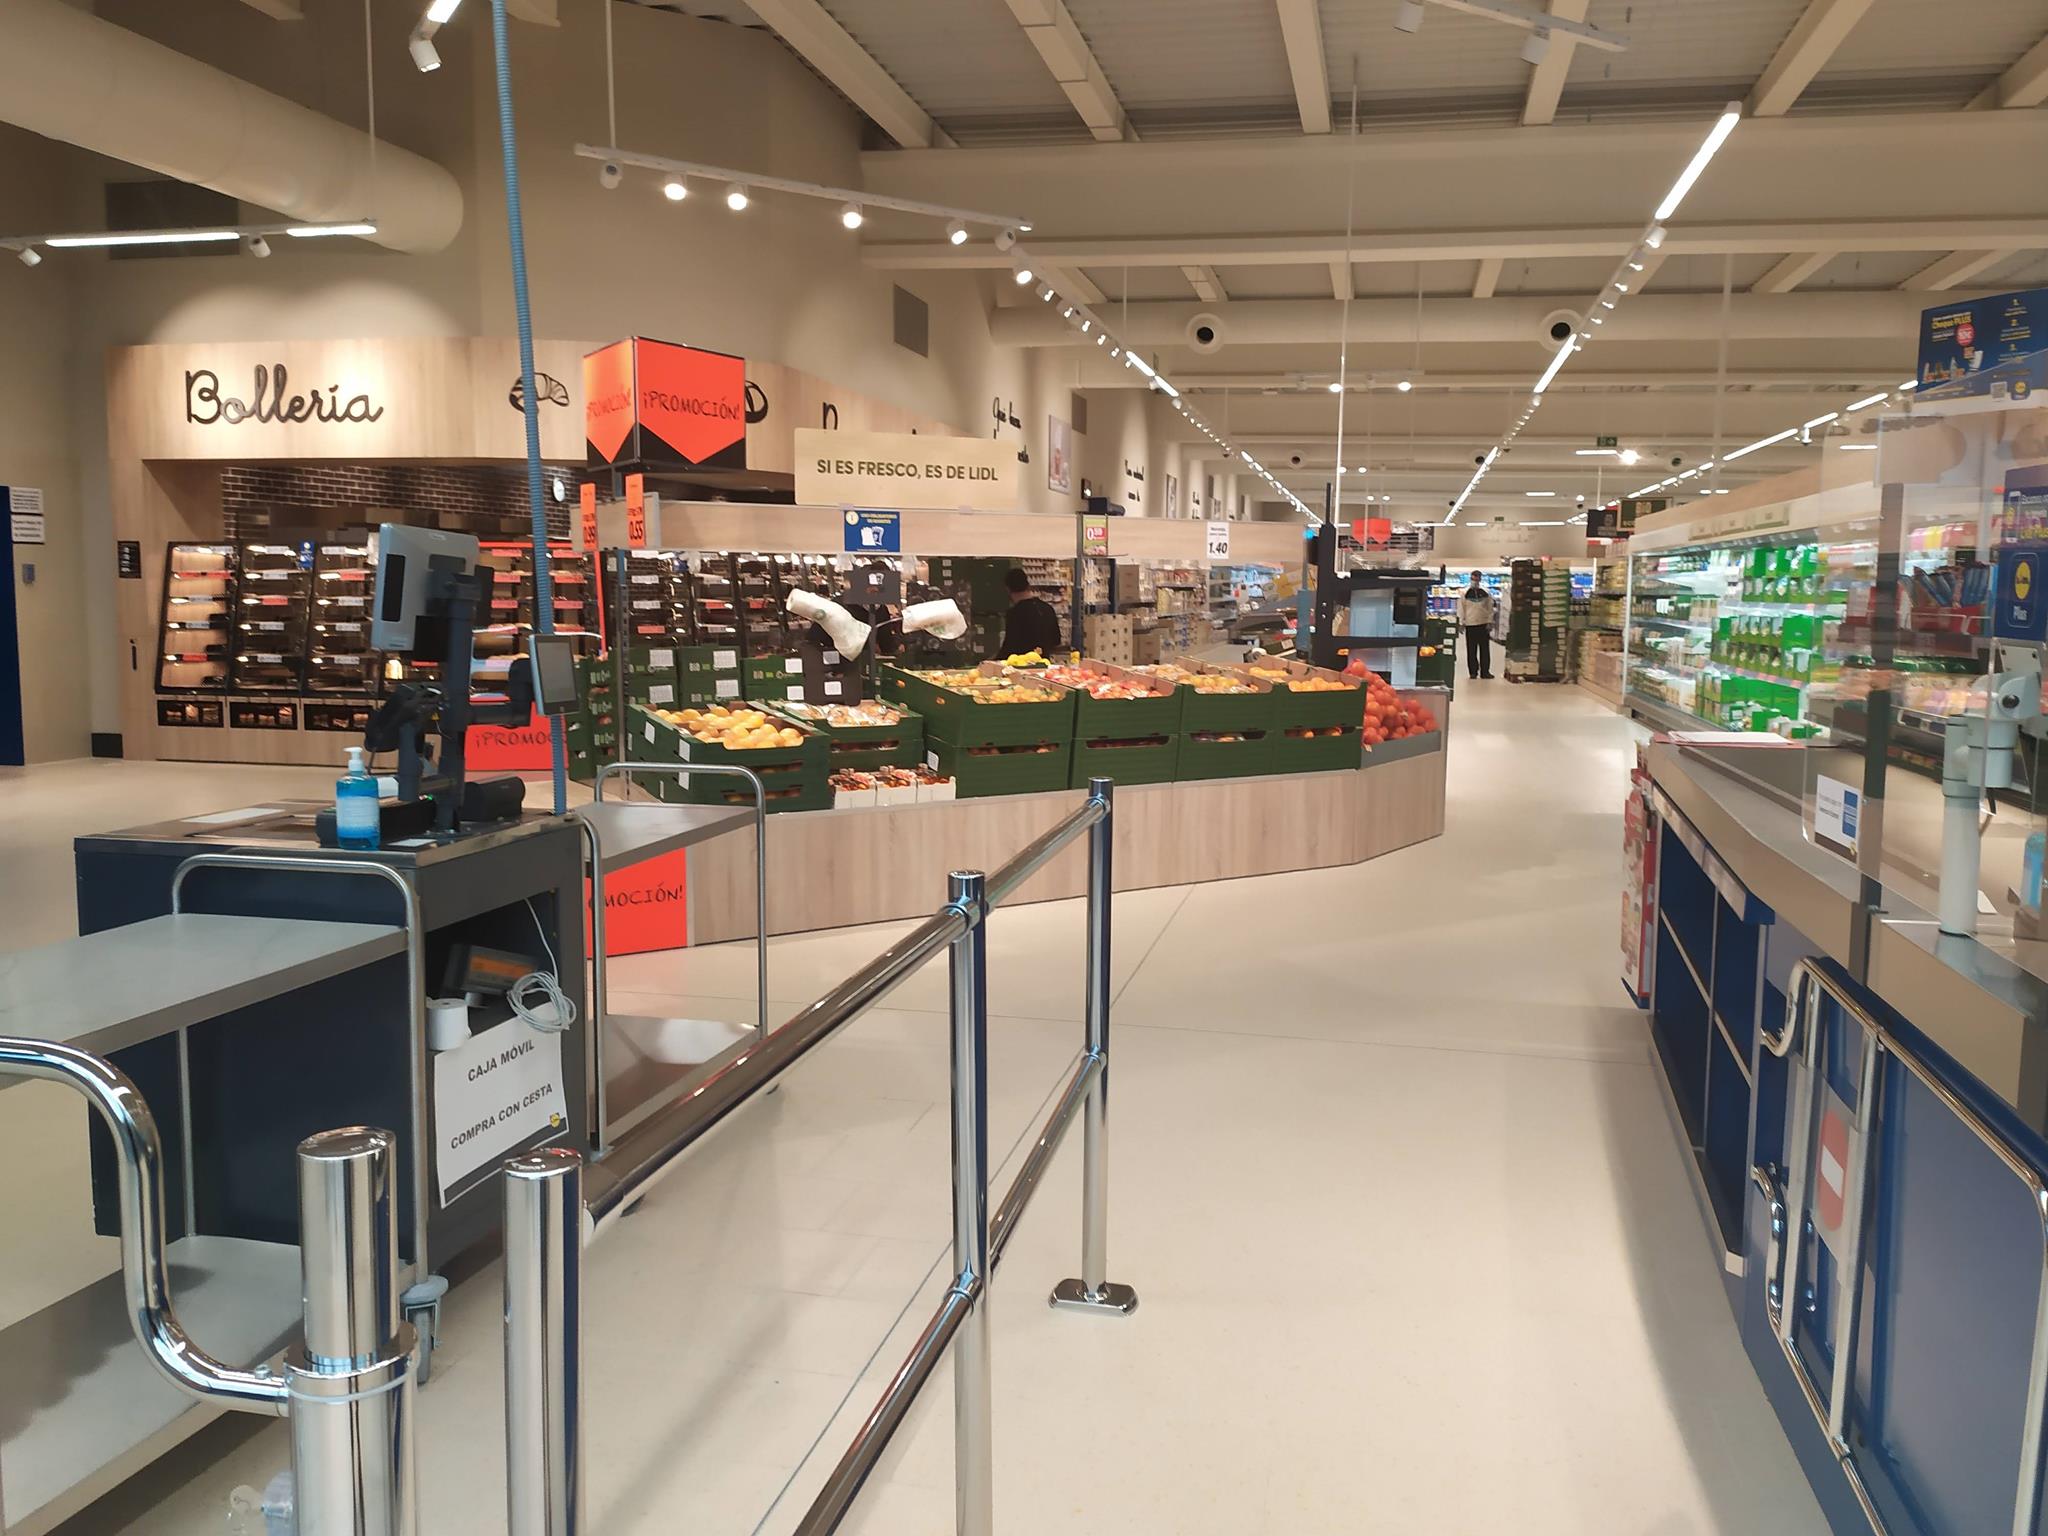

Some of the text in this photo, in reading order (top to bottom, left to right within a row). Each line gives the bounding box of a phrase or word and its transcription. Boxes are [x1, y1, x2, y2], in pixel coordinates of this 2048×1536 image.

[185, 363, 384, 425] Bollería
[643, 390, 740, 421] ¡PROMOCIÓN!
[817, 459, 998, 481] SI ES FRESCO, ES DE LIDL
[1209, 542, 1228, 554] 1.40
[475, 731, 551, 749] ¡PROMO
[588, 881, 683, 908] MOCIÓN!
[468, 1039, 535, 1082] CAJA MÓVIL
[451, 1083, 553, 1149] COMPRA CON CESTA
